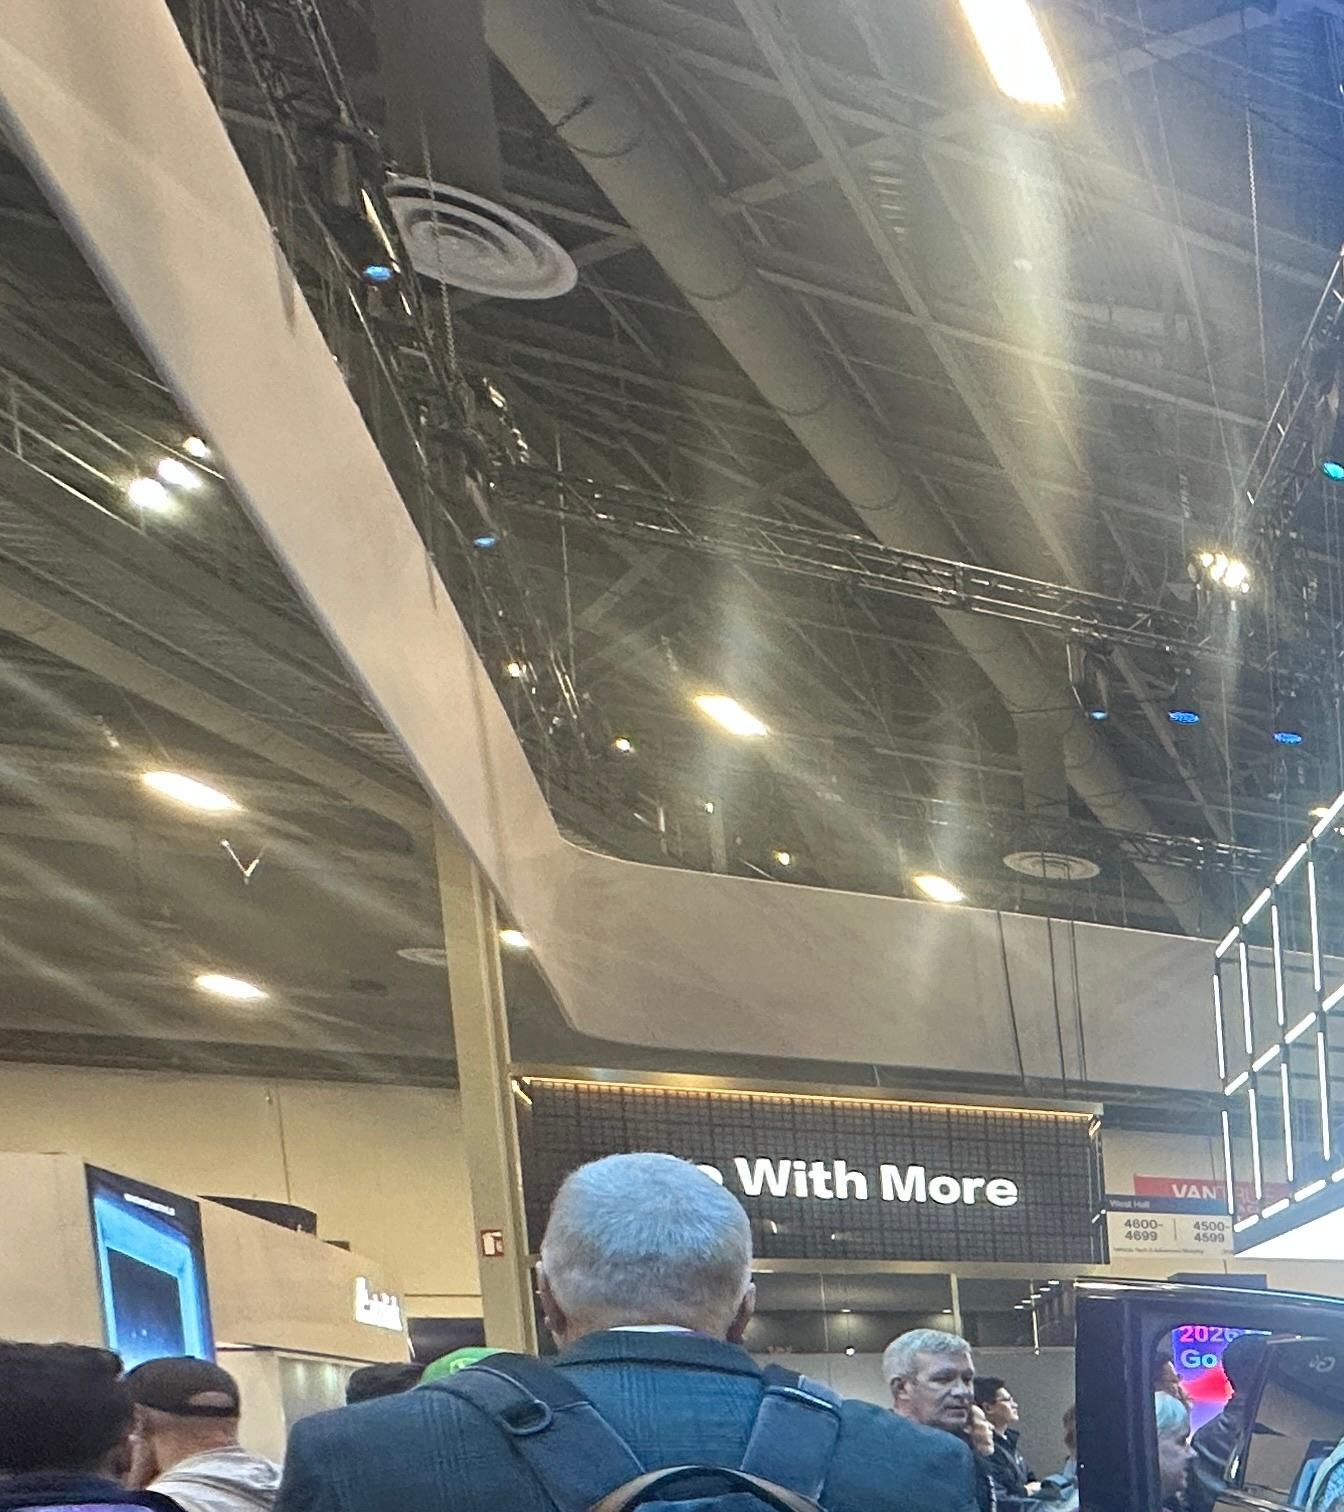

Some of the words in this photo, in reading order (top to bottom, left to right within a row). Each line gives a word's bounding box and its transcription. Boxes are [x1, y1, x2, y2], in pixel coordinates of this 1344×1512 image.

[734, 1157, 867, 1199] With
[880, 1164, 1018, 1206] More
[1124, 1231, 1158, 1241] 4699
[1194, 1233, 1225, 1243] 4599
[1181, 1349, 1217, 1369] Go
